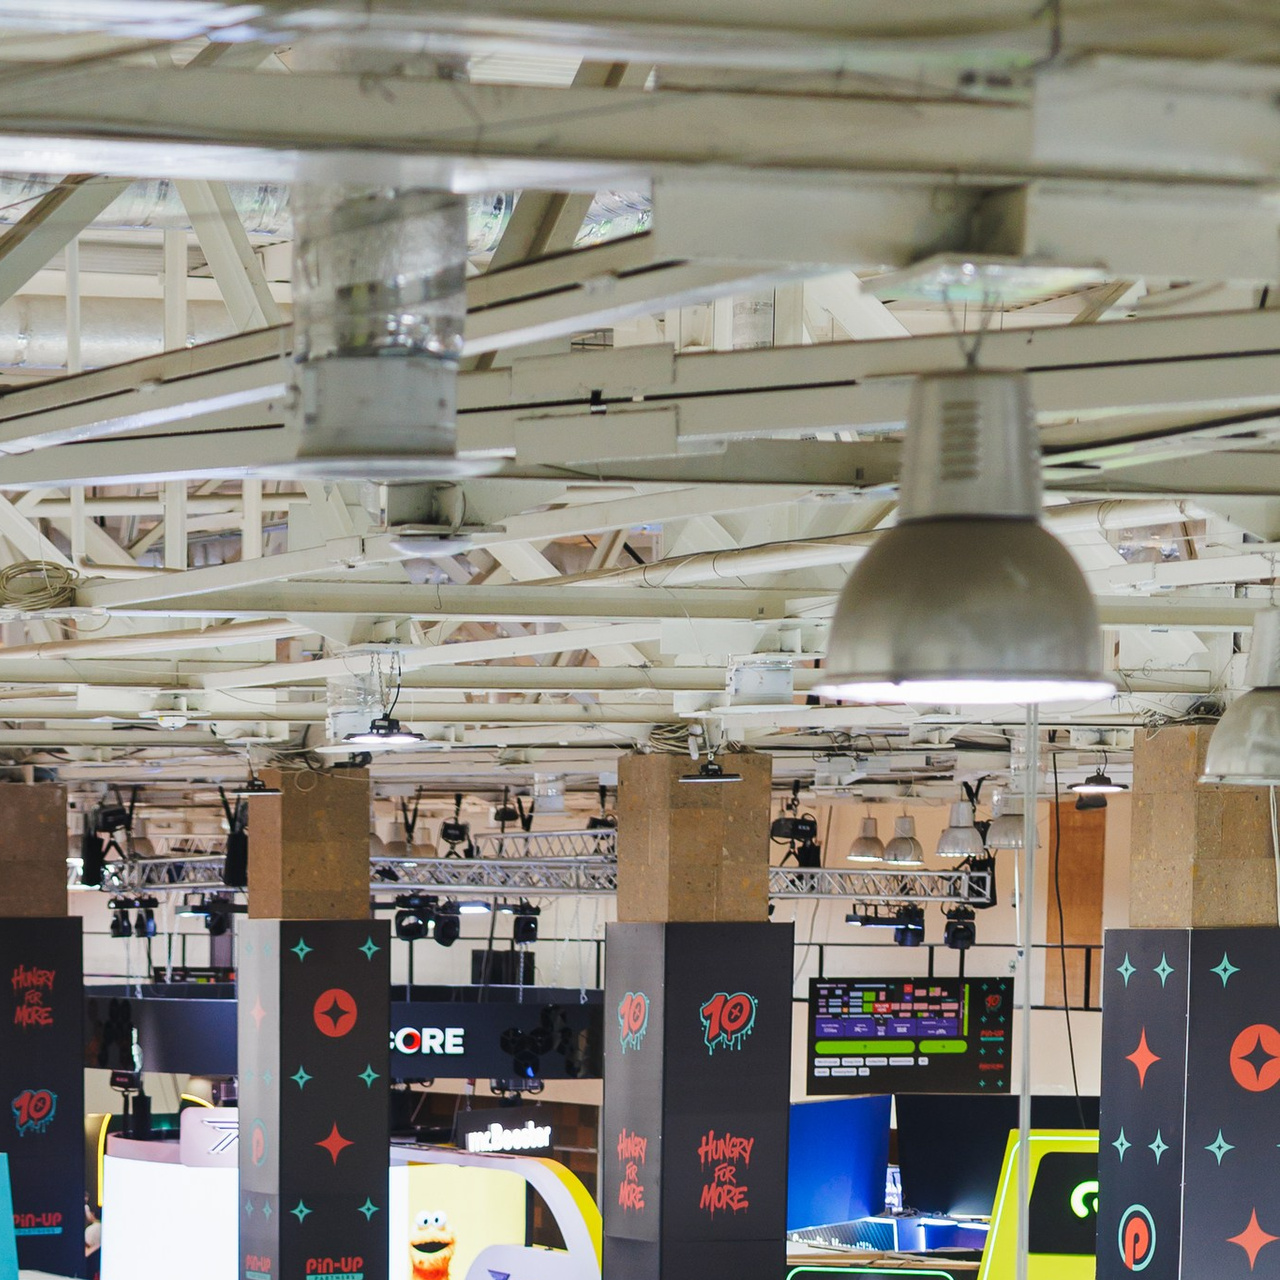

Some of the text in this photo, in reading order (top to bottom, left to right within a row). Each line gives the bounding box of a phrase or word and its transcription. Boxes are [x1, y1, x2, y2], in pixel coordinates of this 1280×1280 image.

[14, 1005, 54, 1026] MORE
[698, 1130, 754, 1166] HUNGRY
[713, 1163, 737, 1185] FOR
[699, 1184, 750, 1214] MORE
